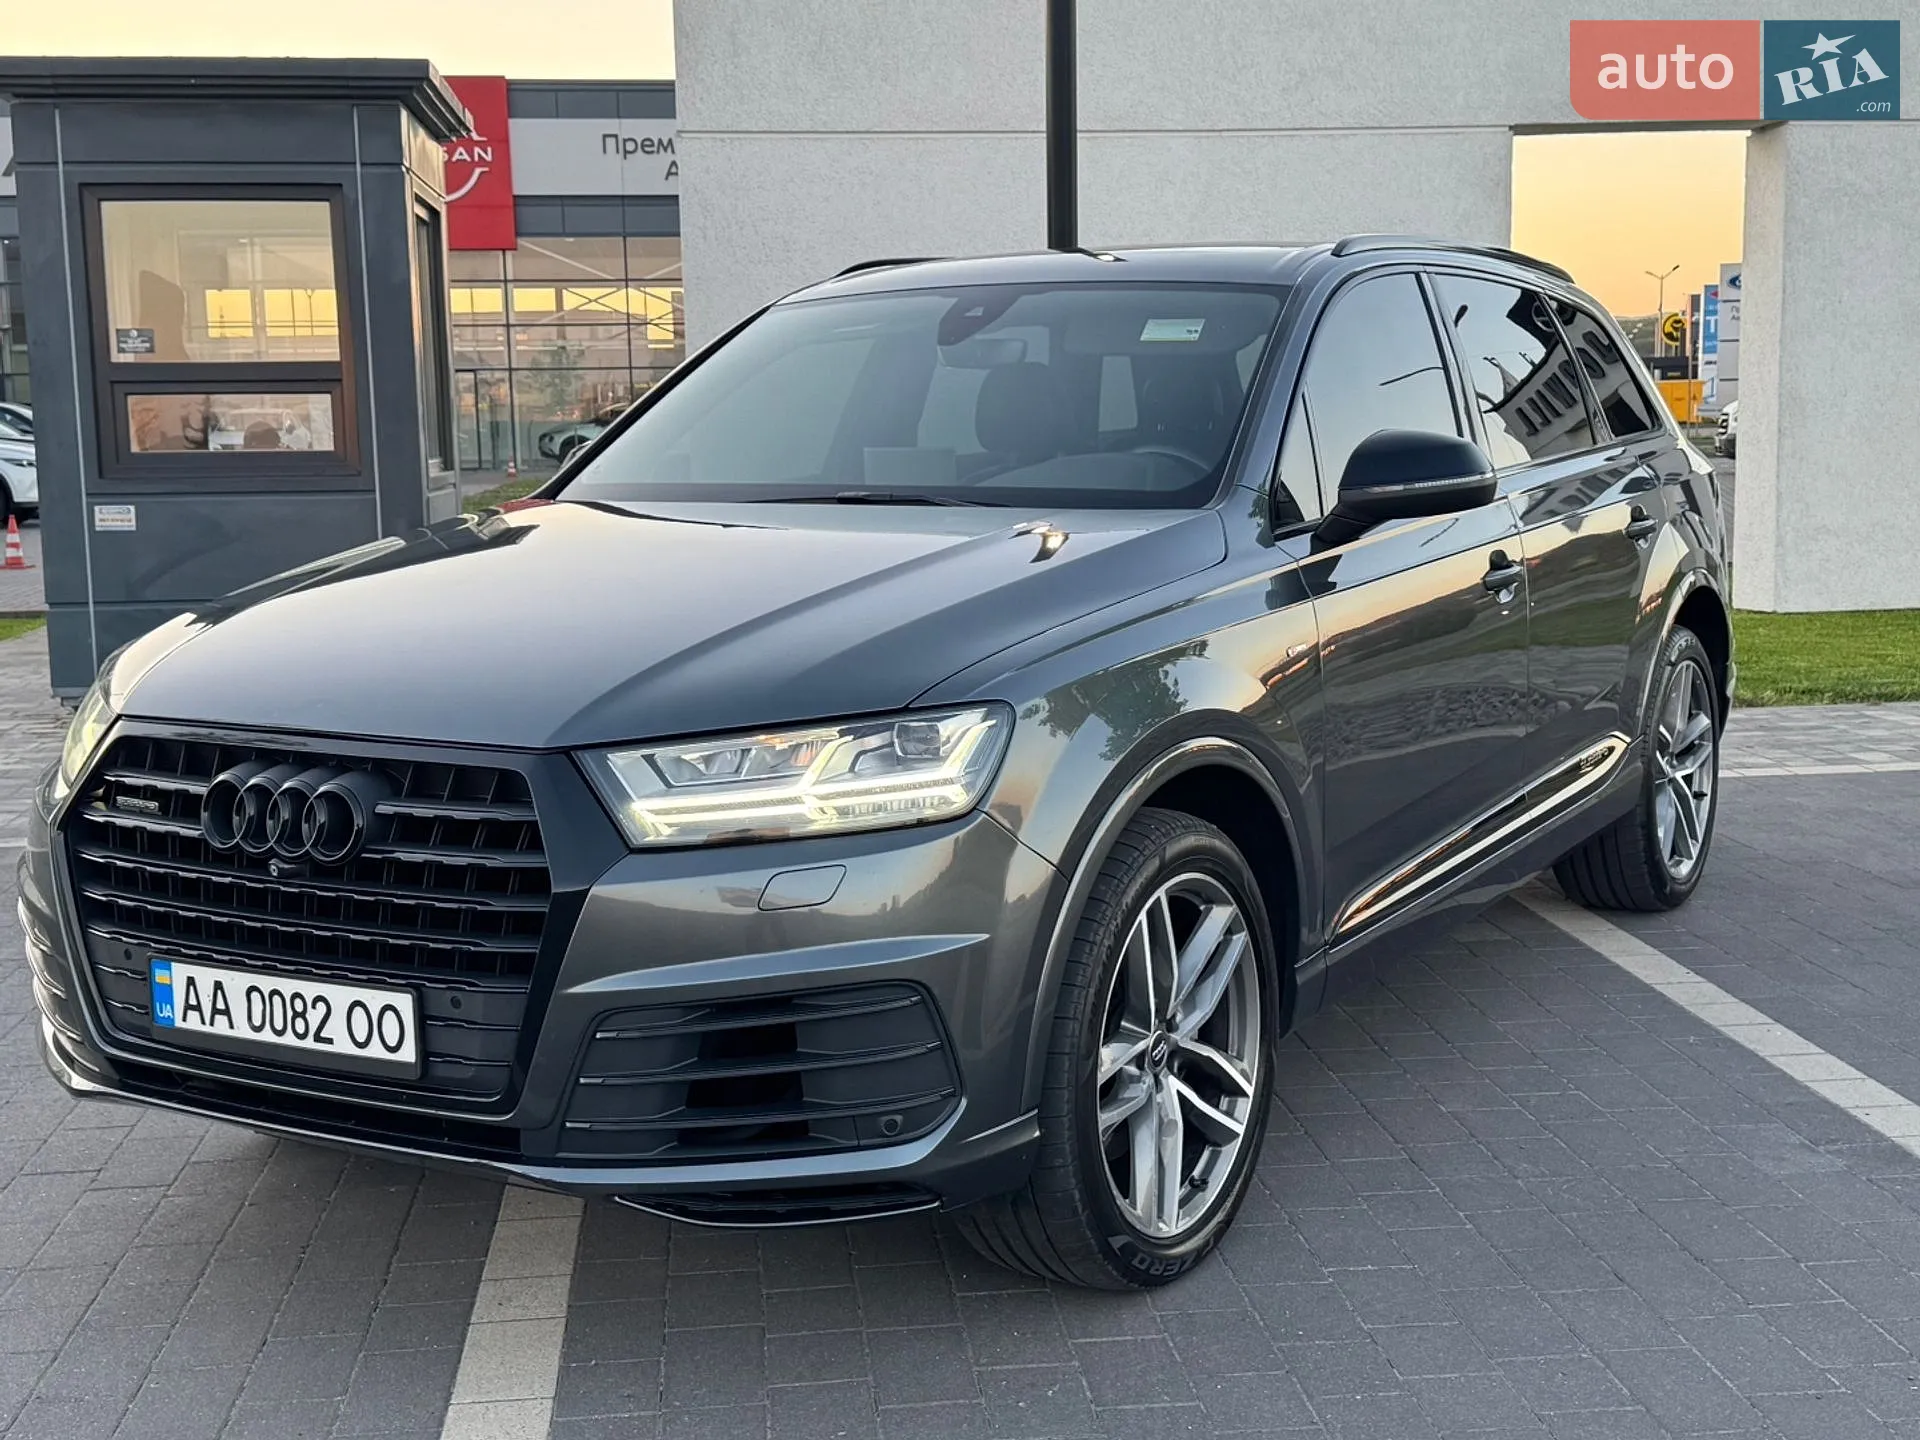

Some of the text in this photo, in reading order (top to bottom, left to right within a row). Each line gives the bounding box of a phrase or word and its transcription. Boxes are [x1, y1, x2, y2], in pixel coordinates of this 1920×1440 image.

[602, 133, 675, 160] Прем
[157, 1003, 174, 1019] UA
[182, 976, 235, 1030] AA
[246, 985, 334, 1045] 0082
